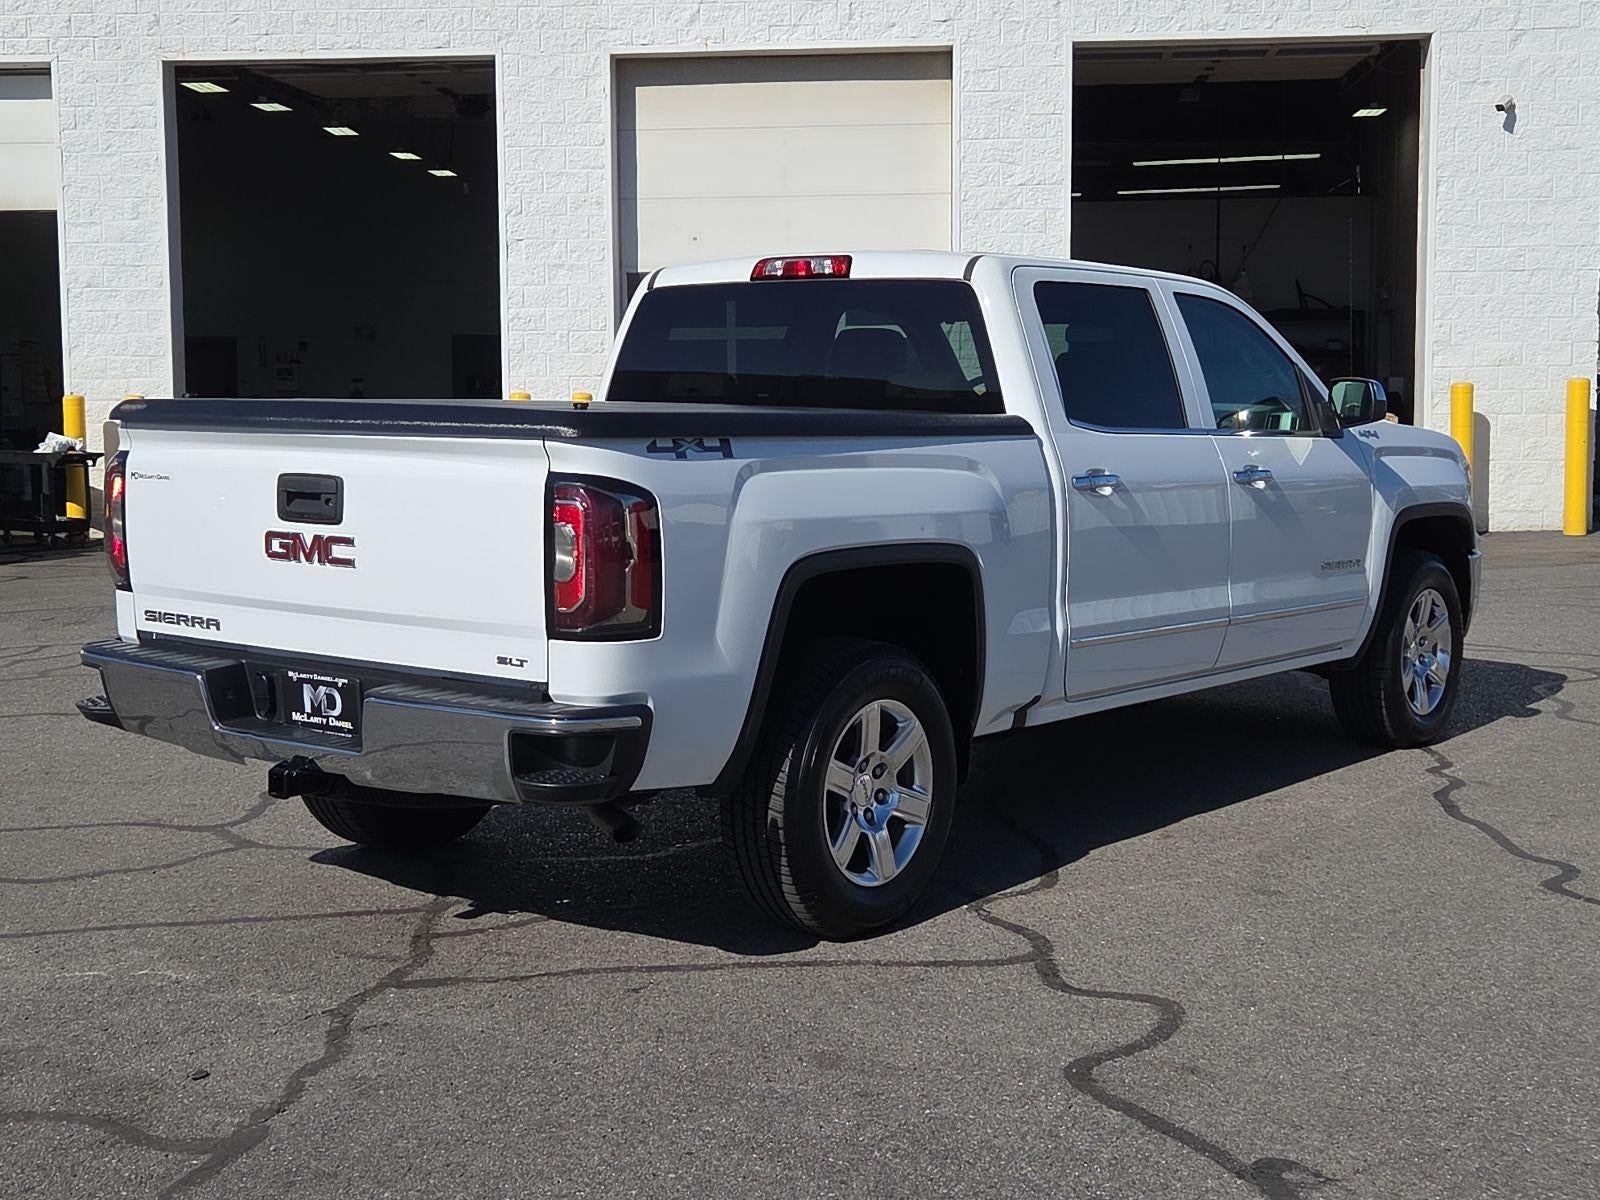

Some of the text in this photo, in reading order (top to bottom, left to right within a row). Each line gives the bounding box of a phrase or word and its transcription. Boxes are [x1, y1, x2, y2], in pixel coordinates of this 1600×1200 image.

[265, 530, 356, 568] GMC
[144, 609, 221, 631] SIERRA
[496, 655, 528, 668] SLT
